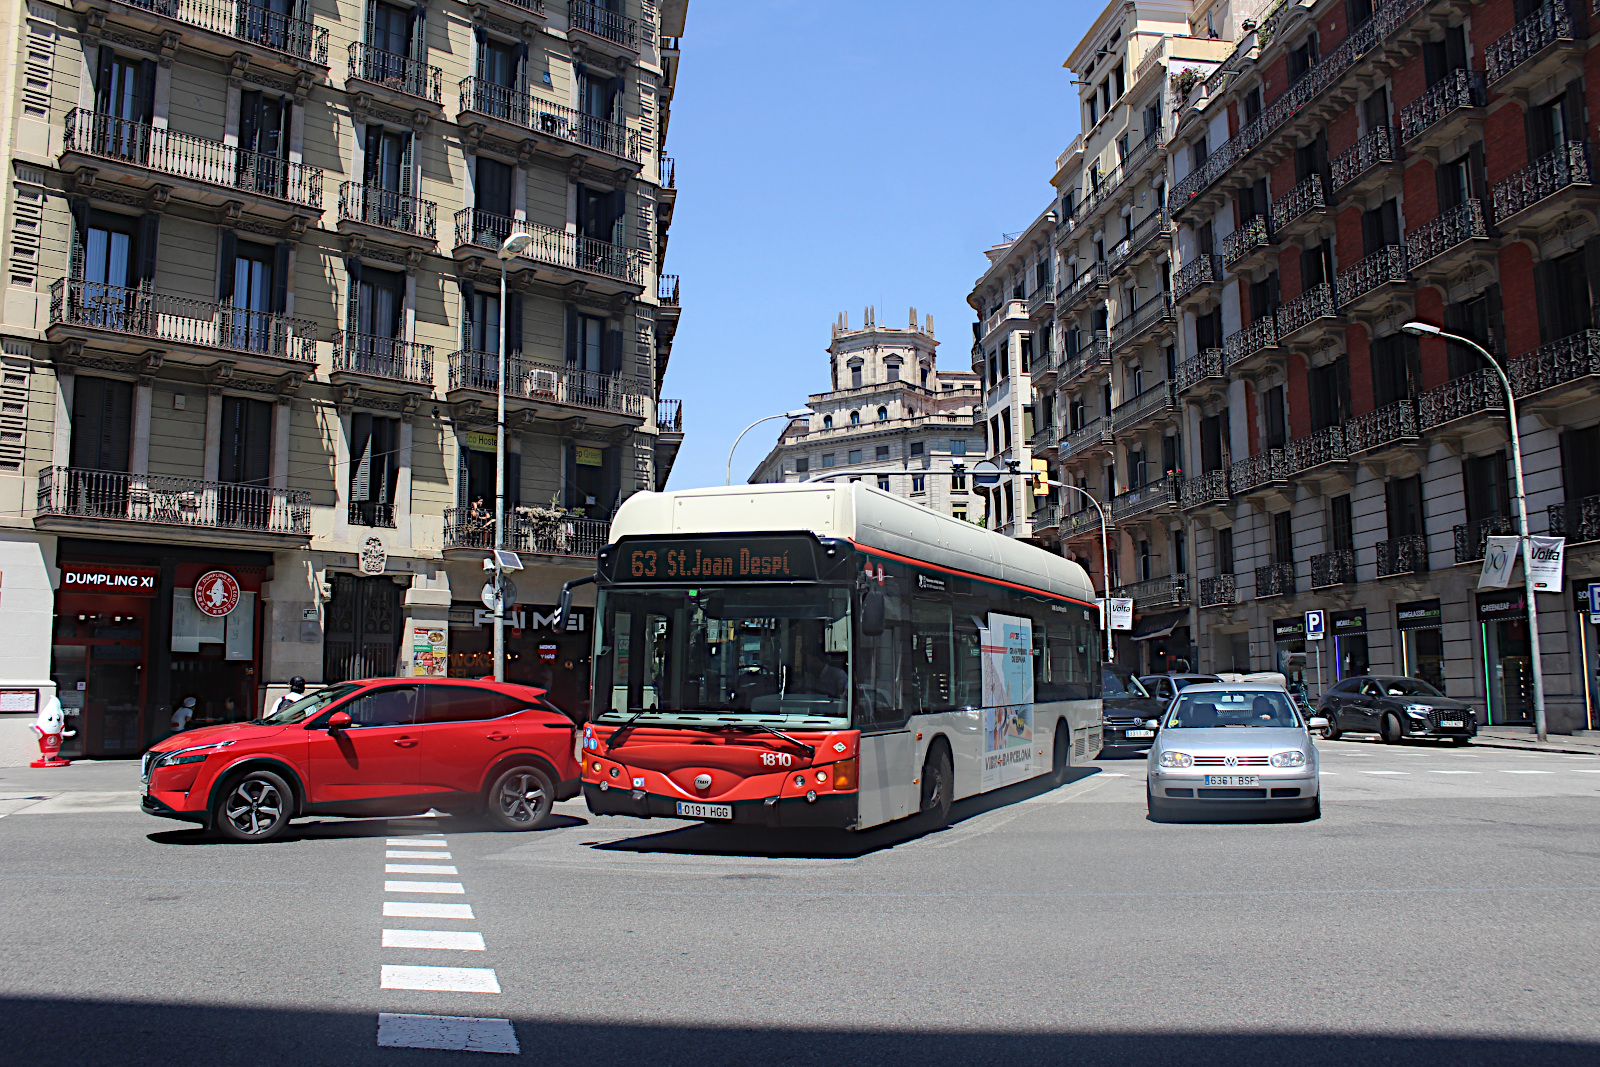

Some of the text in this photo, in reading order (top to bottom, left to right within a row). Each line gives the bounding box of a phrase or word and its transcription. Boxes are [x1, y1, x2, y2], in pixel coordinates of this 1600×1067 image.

[478, 436, 497, 446] Hoste
[584, 450, 600, 459] Green
[1531, 548, 1560, 560] Volta
[631, 548, 790, 576] 63 St.Joan Despí
[66, 572, 154, 588] DUMPLING XI
[202, 574, 227, 584] DUMPLING
[1578, 590, 1590, 599] SO
[1481, 602, 1510, 612] GREENLEAF
[1308, 614, 1320, 631] P
[760, 752, 792, 767] 1810
[1002, 748, 1031, 766] BARCELONA
[1210, 776, 1255, 785] 6361 BSF
[684, 805, 728, 817] 0191 HGG
